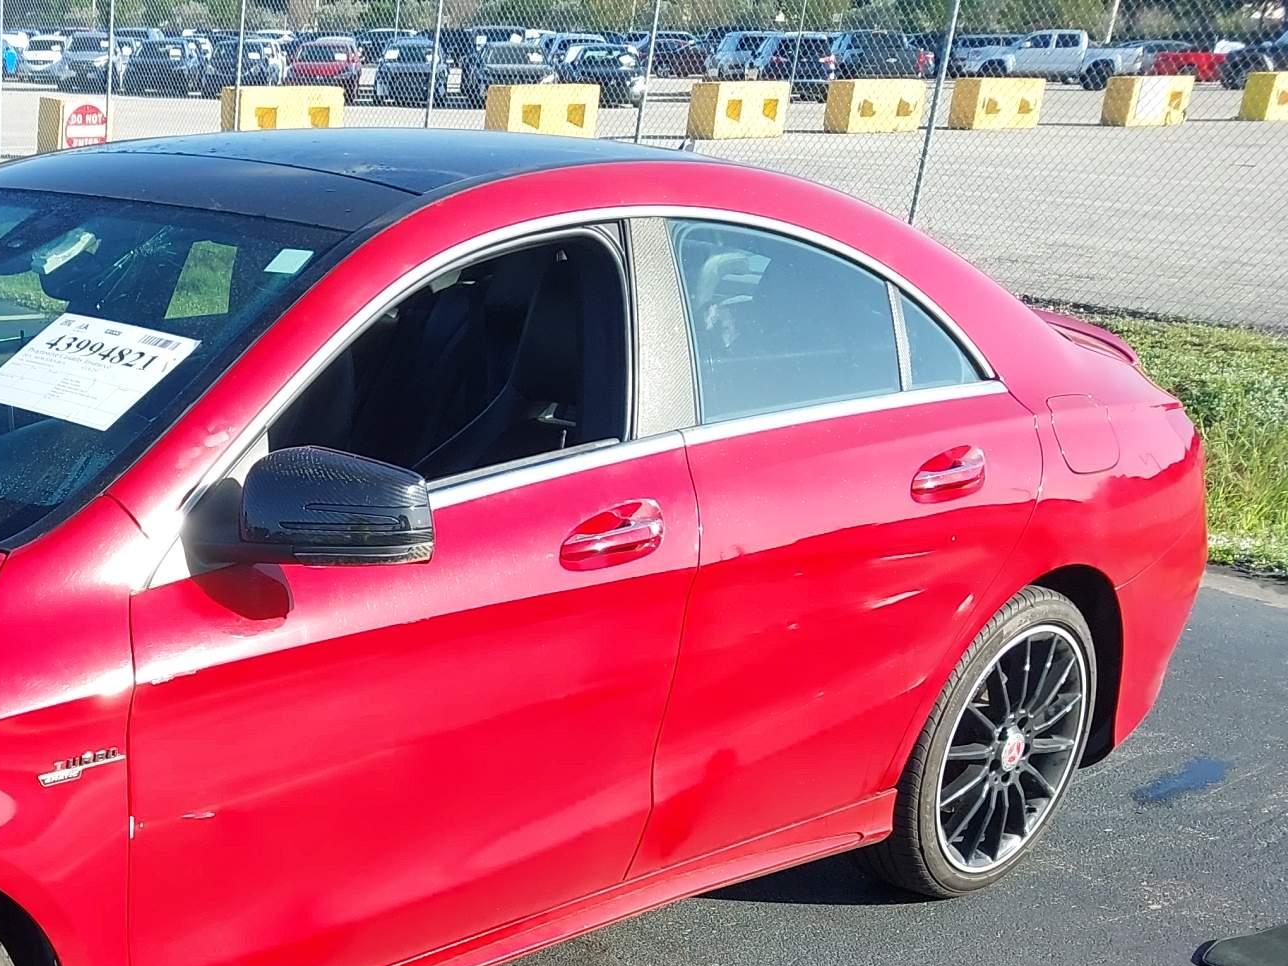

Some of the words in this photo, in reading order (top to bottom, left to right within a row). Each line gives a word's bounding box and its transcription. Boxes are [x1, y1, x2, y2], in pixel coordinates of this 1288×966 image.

[69, 113, 82, 125] DO
[86, 113, 102, 125] NOT
[45, 335, 159, 371] 43994821
